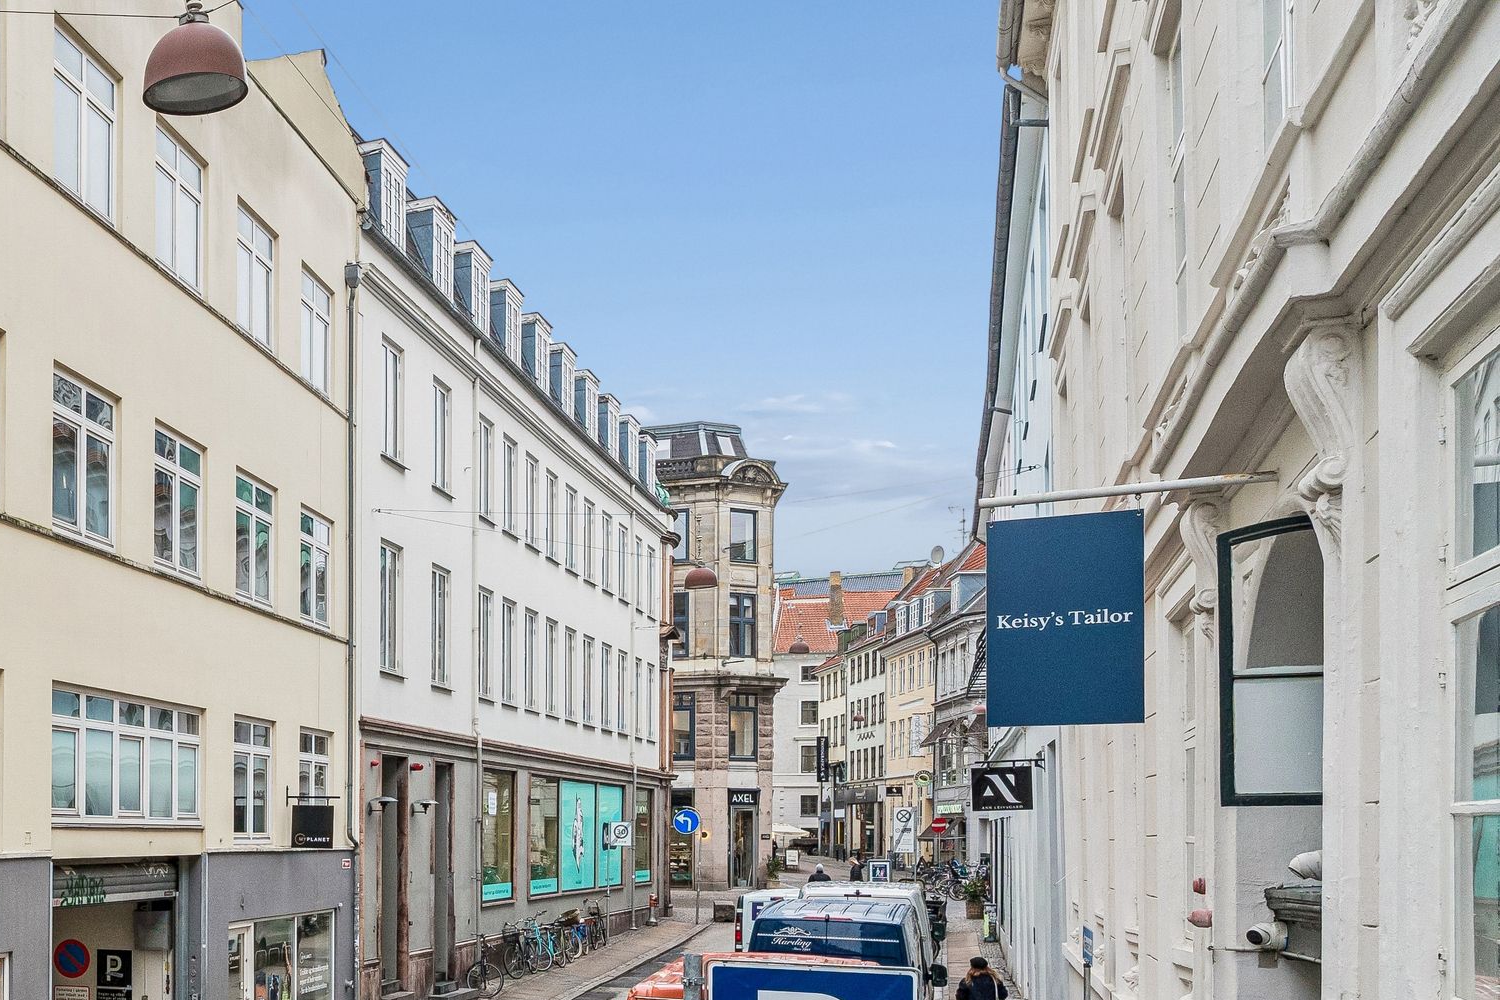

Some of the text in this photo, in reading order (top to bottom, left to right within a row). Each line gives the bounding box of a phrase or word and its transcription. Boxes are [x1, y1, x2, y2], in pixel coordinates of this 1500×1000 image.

[996, 608, 1134, 631] Keisy's Tailor
[731, 793, 754, 803] AXEL
[771, 937, 812, 948] Harding
